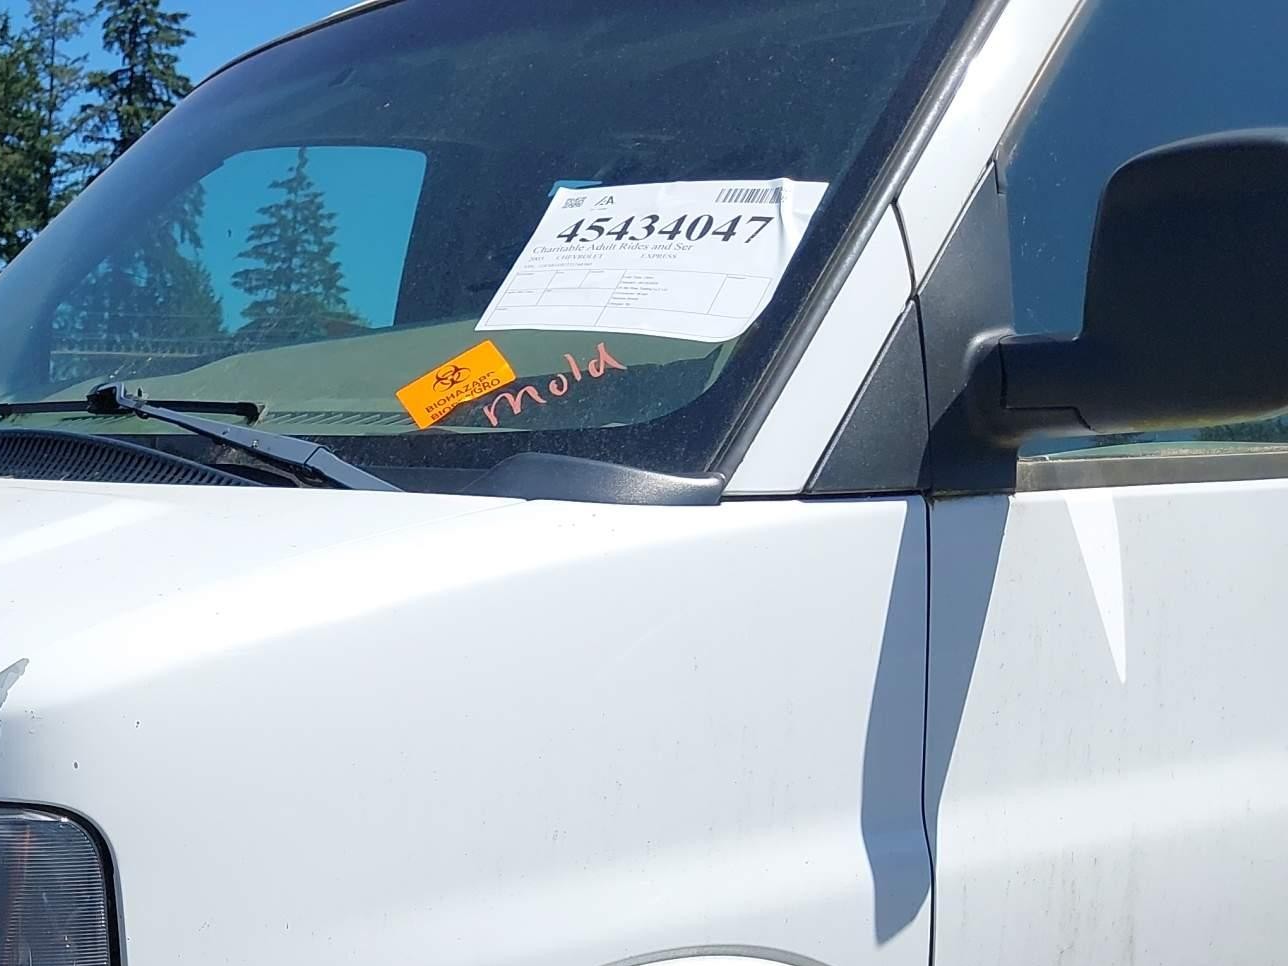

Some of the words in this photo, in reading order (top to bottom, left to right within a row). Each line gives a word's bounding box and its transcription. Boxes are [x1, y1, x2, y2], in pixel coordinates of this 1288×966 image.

[556, 214, 774, 243] 45434047
[532, 243, 585, 255] Charitable
[586, 242, 616, 252] Adult
[619, 241, 648, 251] Rides
[650, 242, 673, 251] and
[674, 242, 695, 251] Ser
